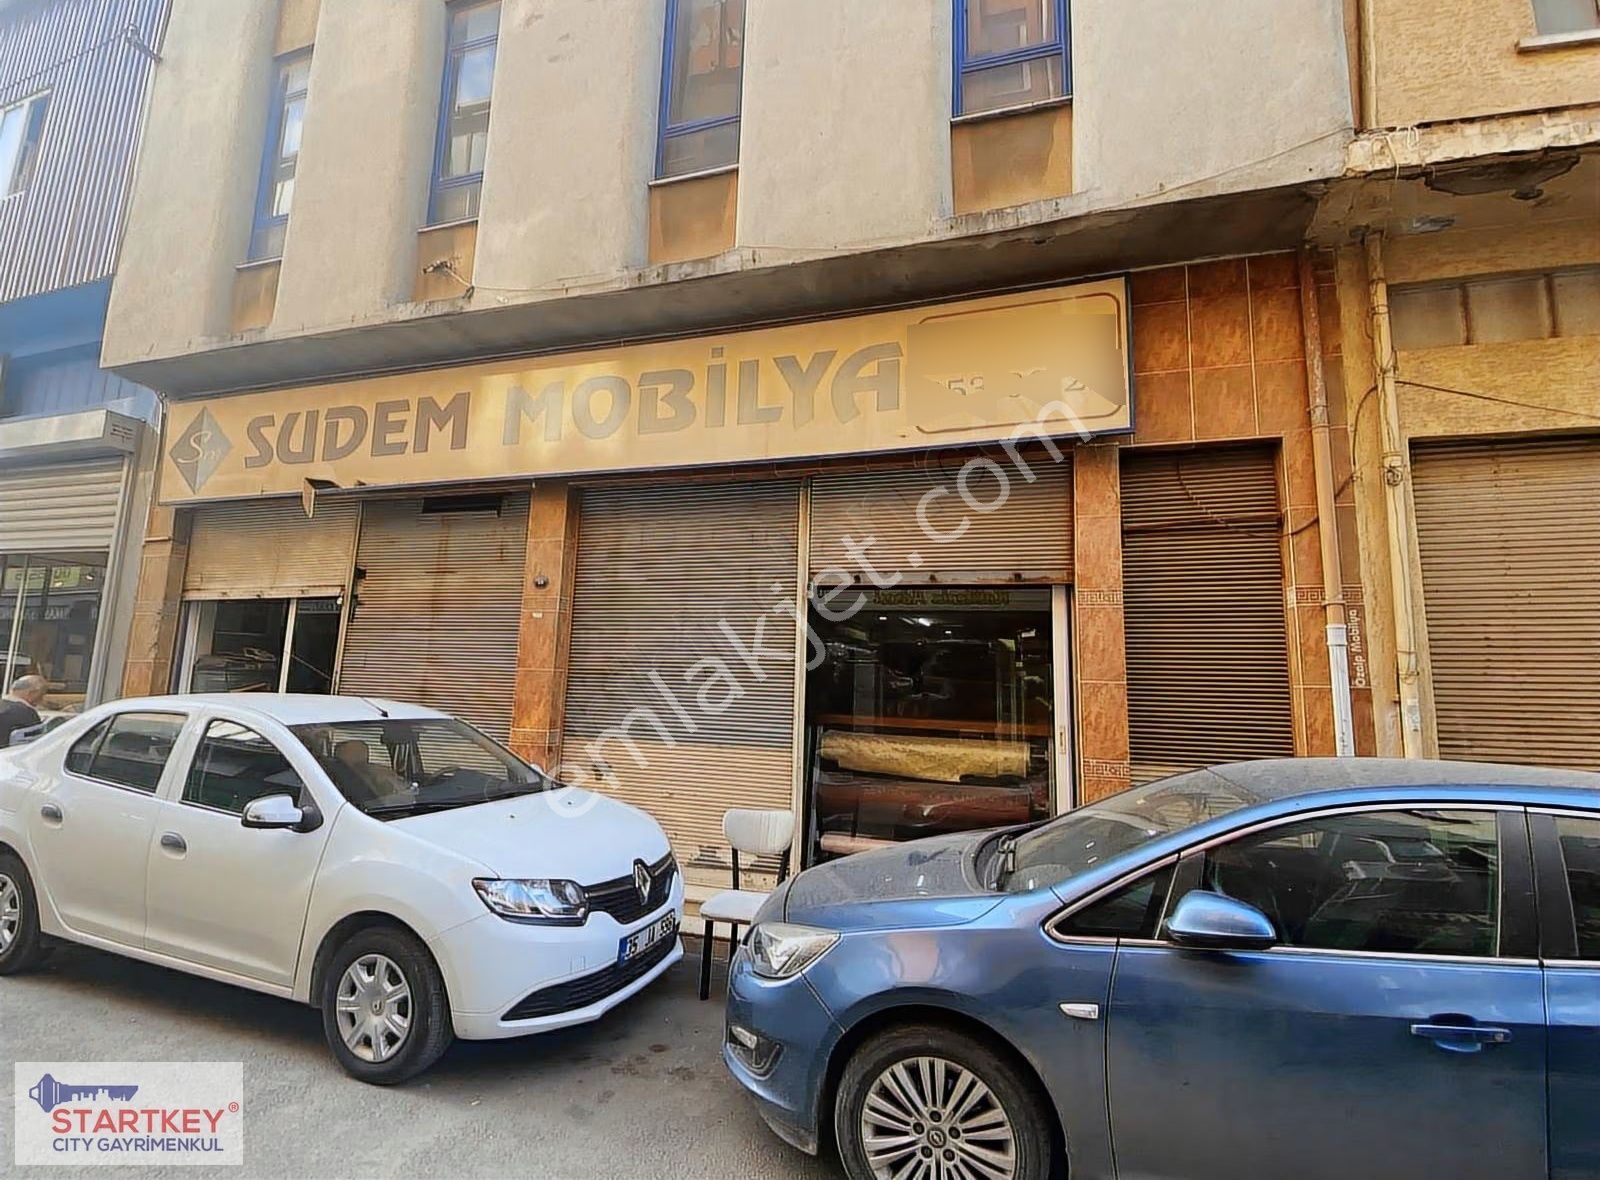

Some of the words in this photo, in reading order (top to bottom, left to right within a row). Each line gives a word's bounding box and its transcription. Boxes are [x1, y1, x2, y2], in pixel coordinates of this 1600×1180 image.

[503, 340, 904, 446] MOBİLYA
[1347, 609, 1362, 653] Mobilya
[624, 935, 640, 958] 35
